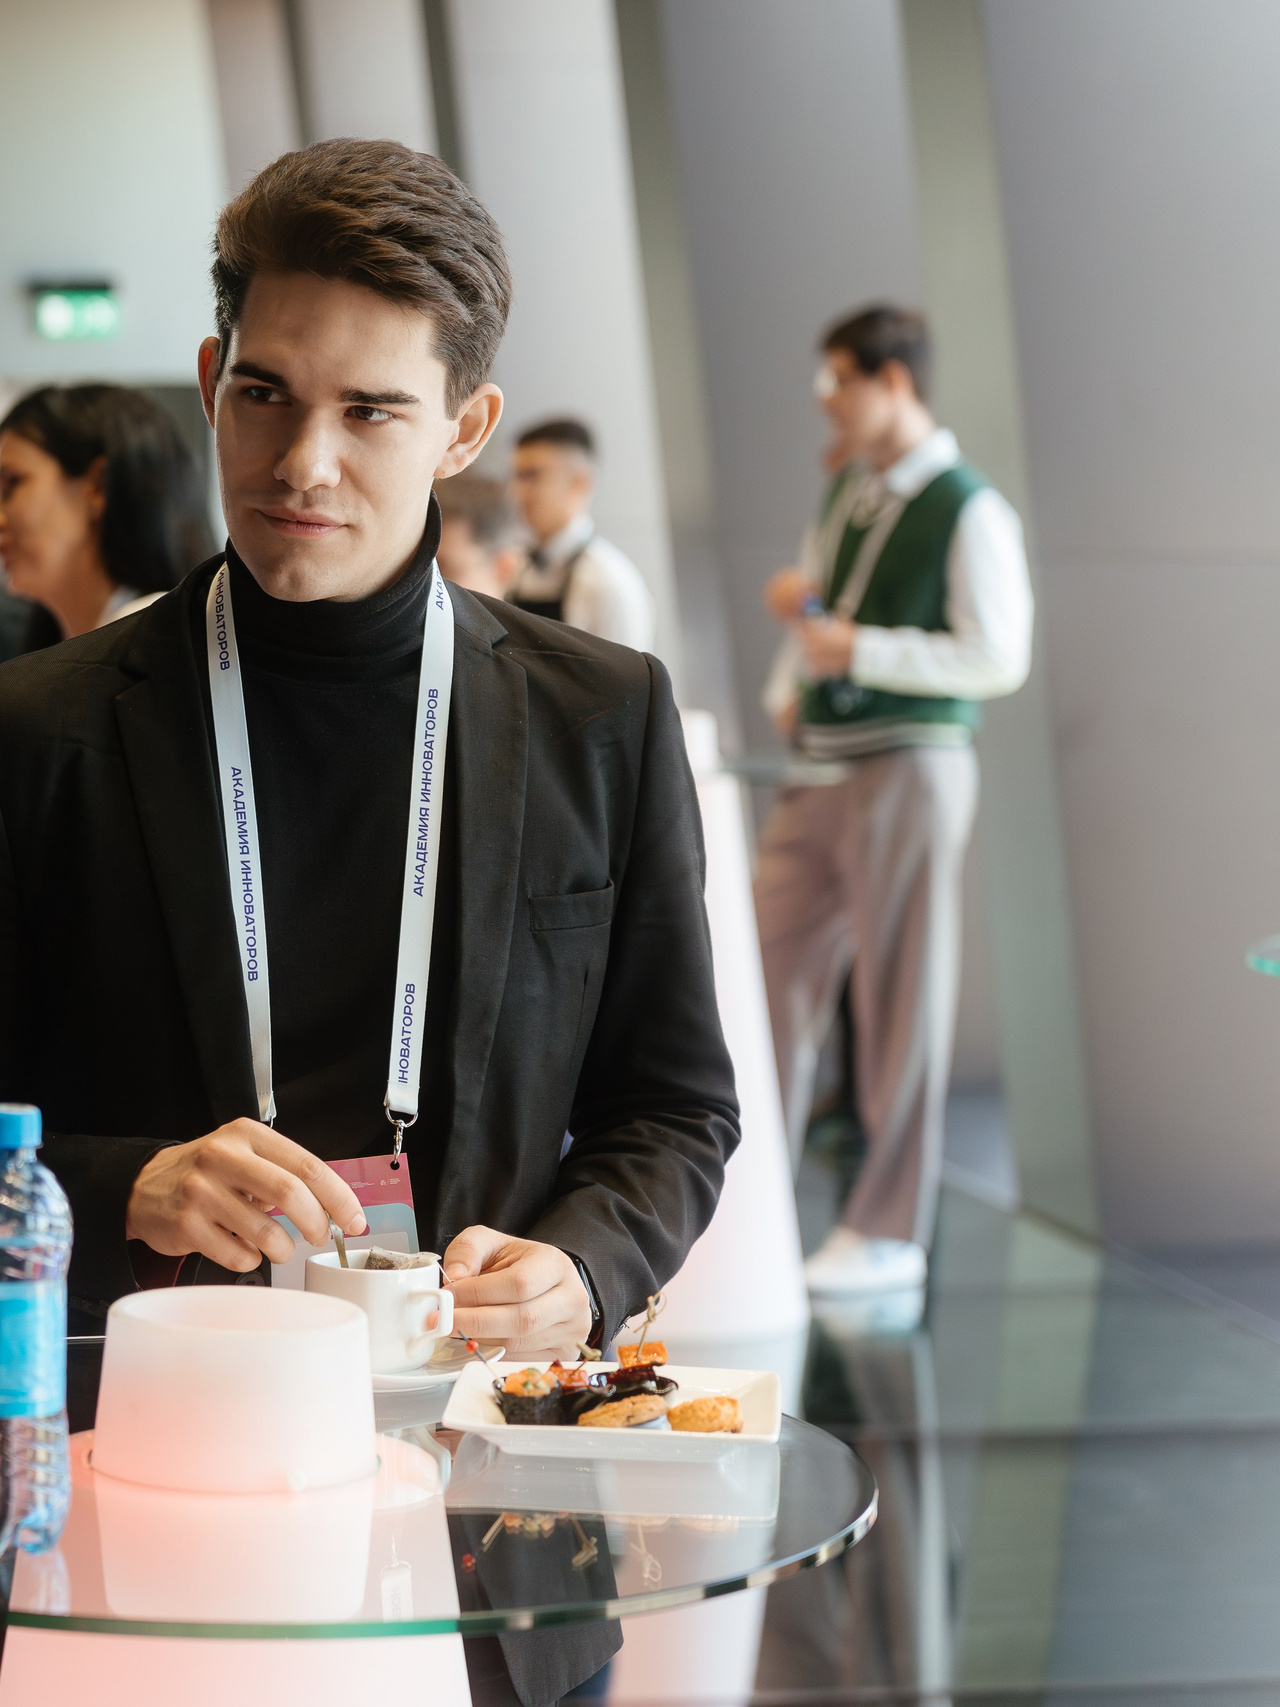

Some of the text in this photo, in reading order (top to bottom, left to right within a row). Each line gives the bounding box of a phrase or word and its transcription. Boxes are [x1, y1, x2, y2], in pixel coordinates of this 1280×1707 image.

[231, 766, 258, 982] АКАДЕМИЯ ИННОВАТОРОВ
[413, 688, 439, 897] АКАДЕМИЯ ИННОВАТОРОВ
